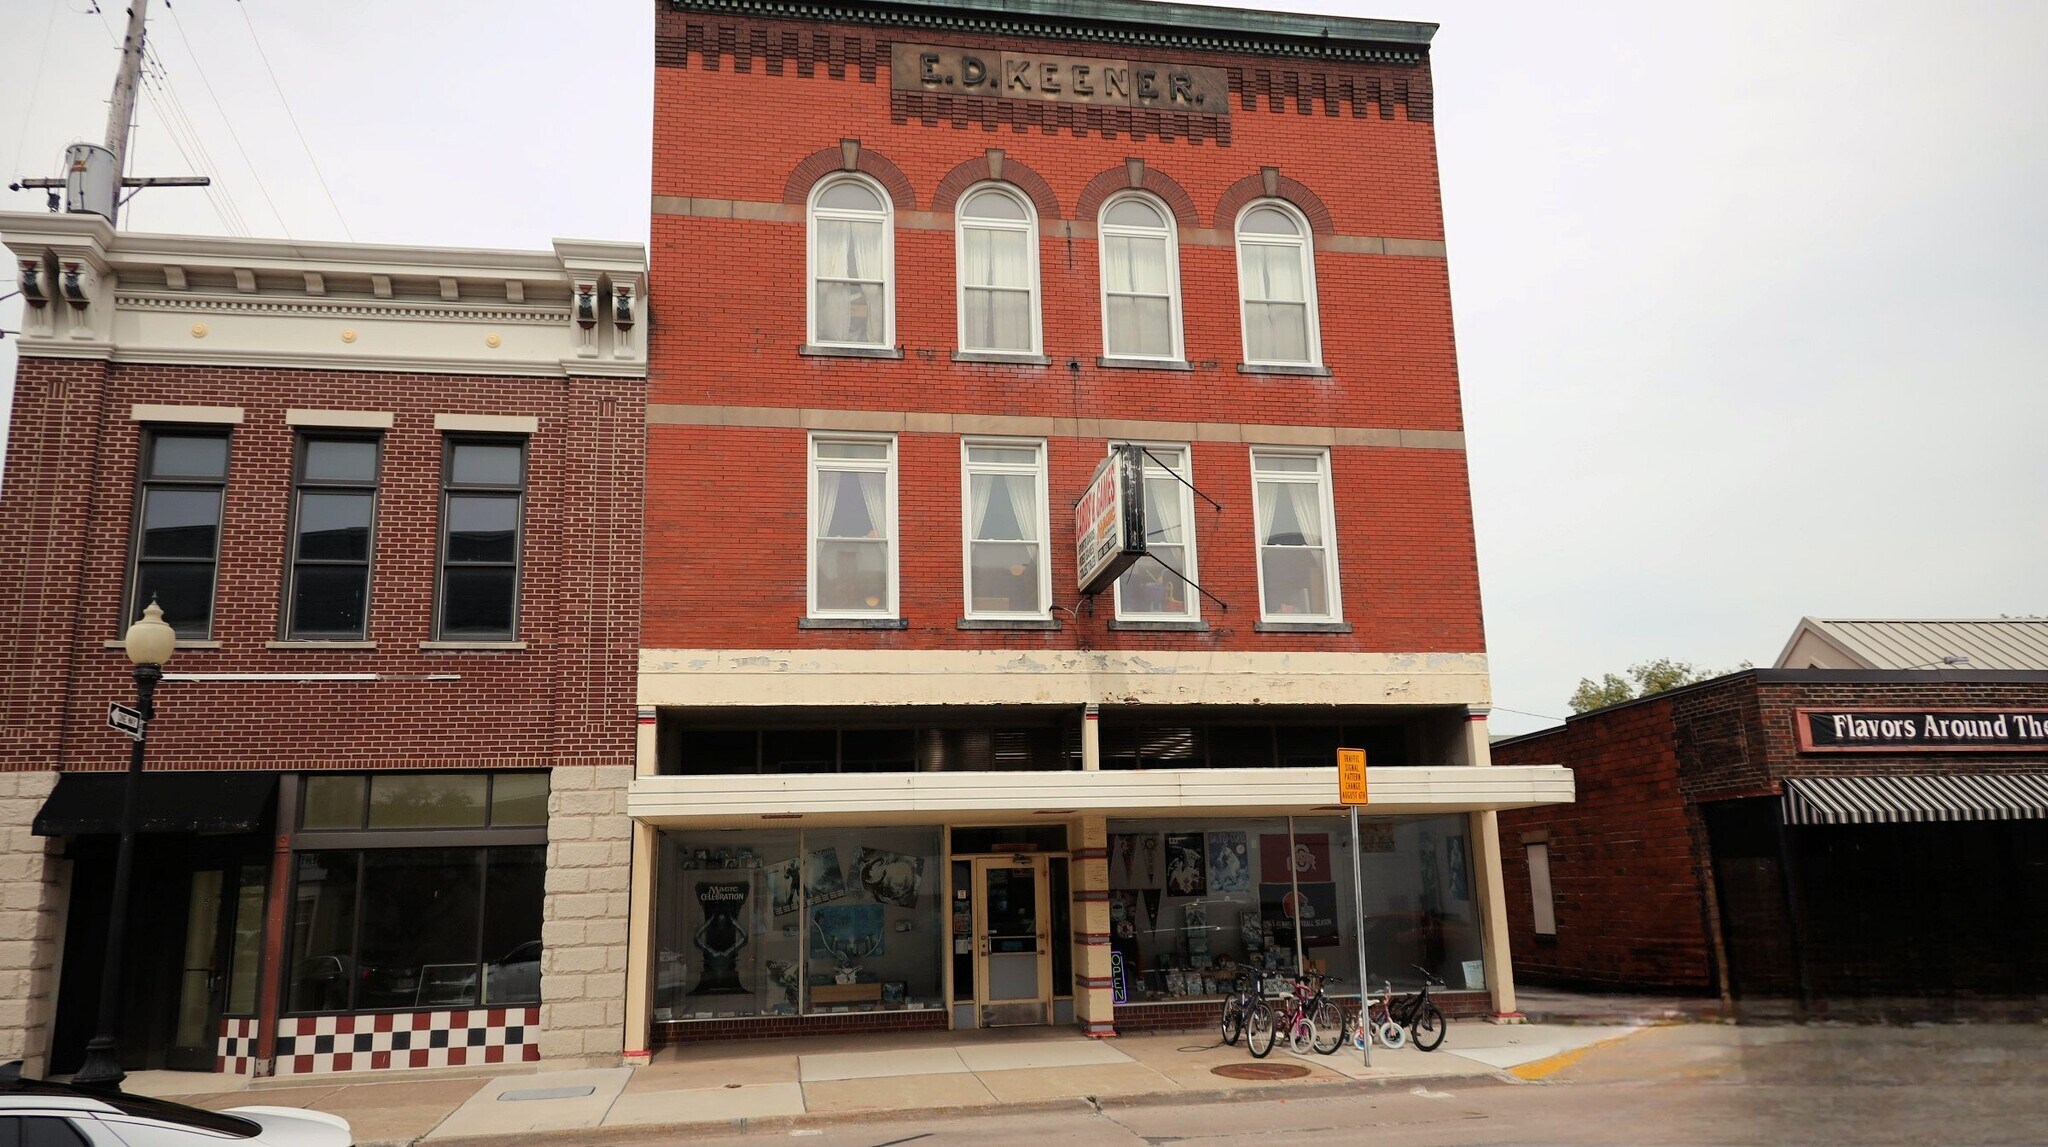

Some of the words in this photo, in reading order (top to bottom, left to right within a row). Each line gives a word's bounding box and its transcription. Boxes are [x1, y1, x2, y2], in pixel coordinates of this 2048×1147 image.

[1097, 463, 1115, 518] GAMES
[1832, 714, 1916, 738] Flavors
[1923, 714, 2009, 738] Around
[1344, 754, 1360, 763] TRAFFIC
[1345, 764, 1360, 772] SIGNAL
[1344, 772, 1361, 781] PATTERN
[1345, 782, 1361, 791] CHANGE
[709, 886, 738, 895] MAGIC
[700, 893, 744, 901] CELEBRATION
[1111, 953, 1124, 1001] OPEN
